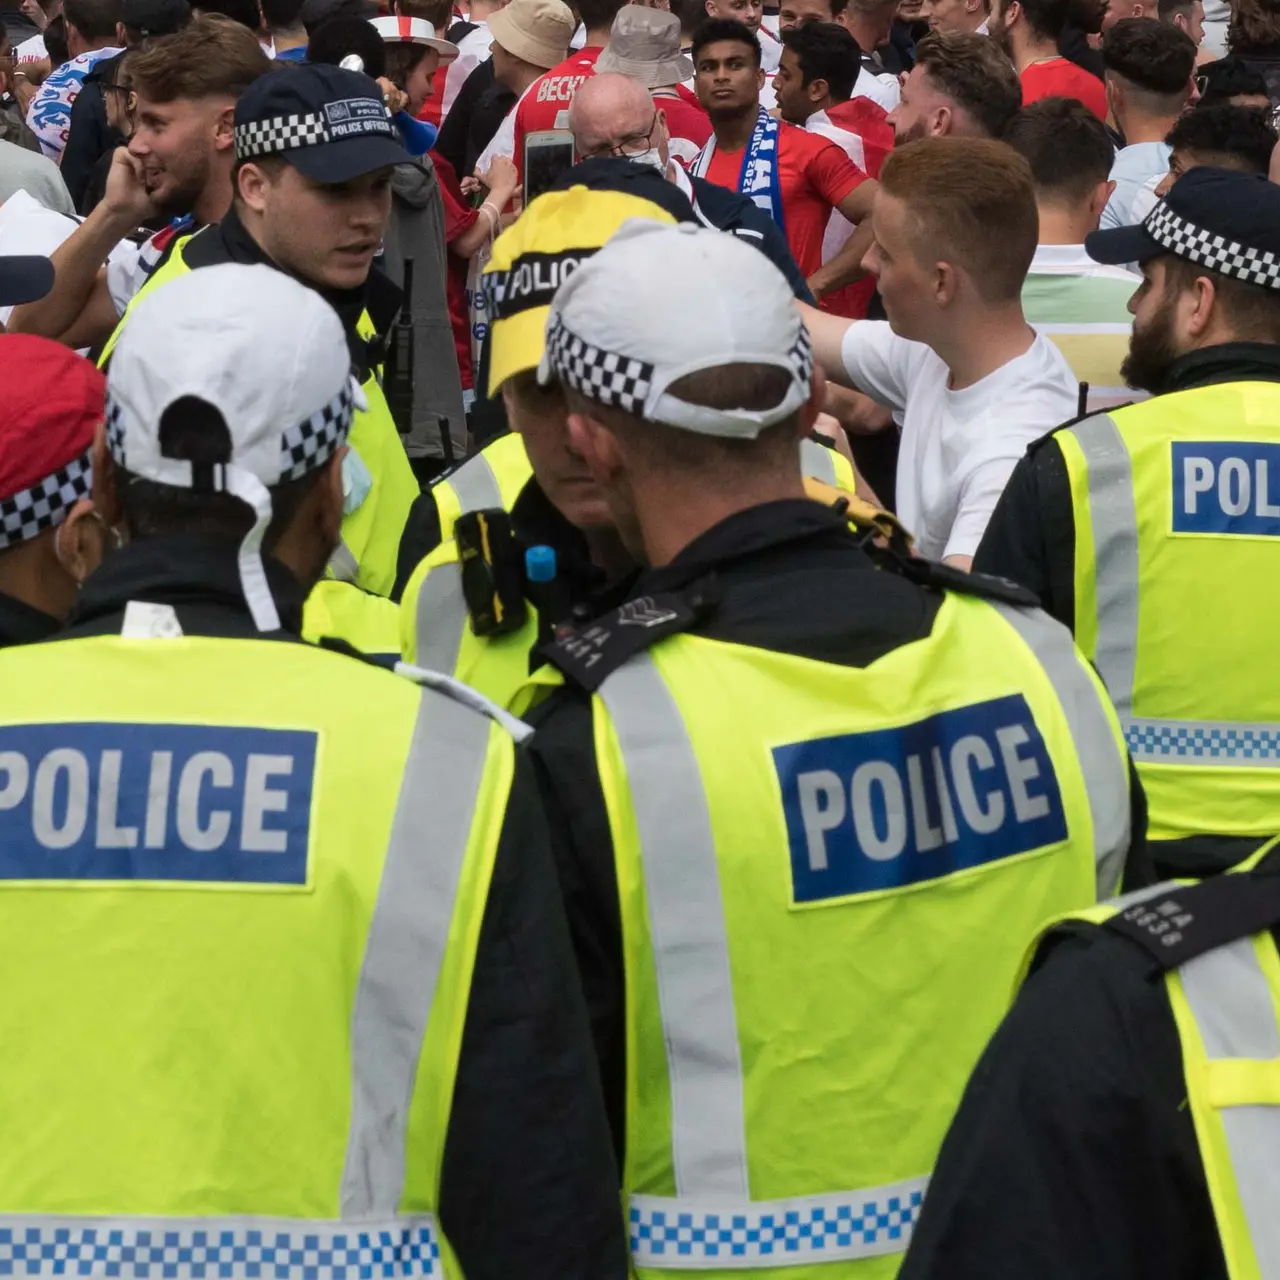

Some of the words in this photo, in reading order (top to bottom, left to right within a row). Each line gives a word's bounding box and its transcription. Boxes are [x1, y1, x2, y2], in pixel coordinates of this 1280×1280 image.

[331, 121, 362, 137] POLICE
[363, 120, 390, 131] OFFICER
[751, 126, 764, 157] JULY
[743, 161, 756, 193] 2021
[797, 723, 1051, 872] POLICE
